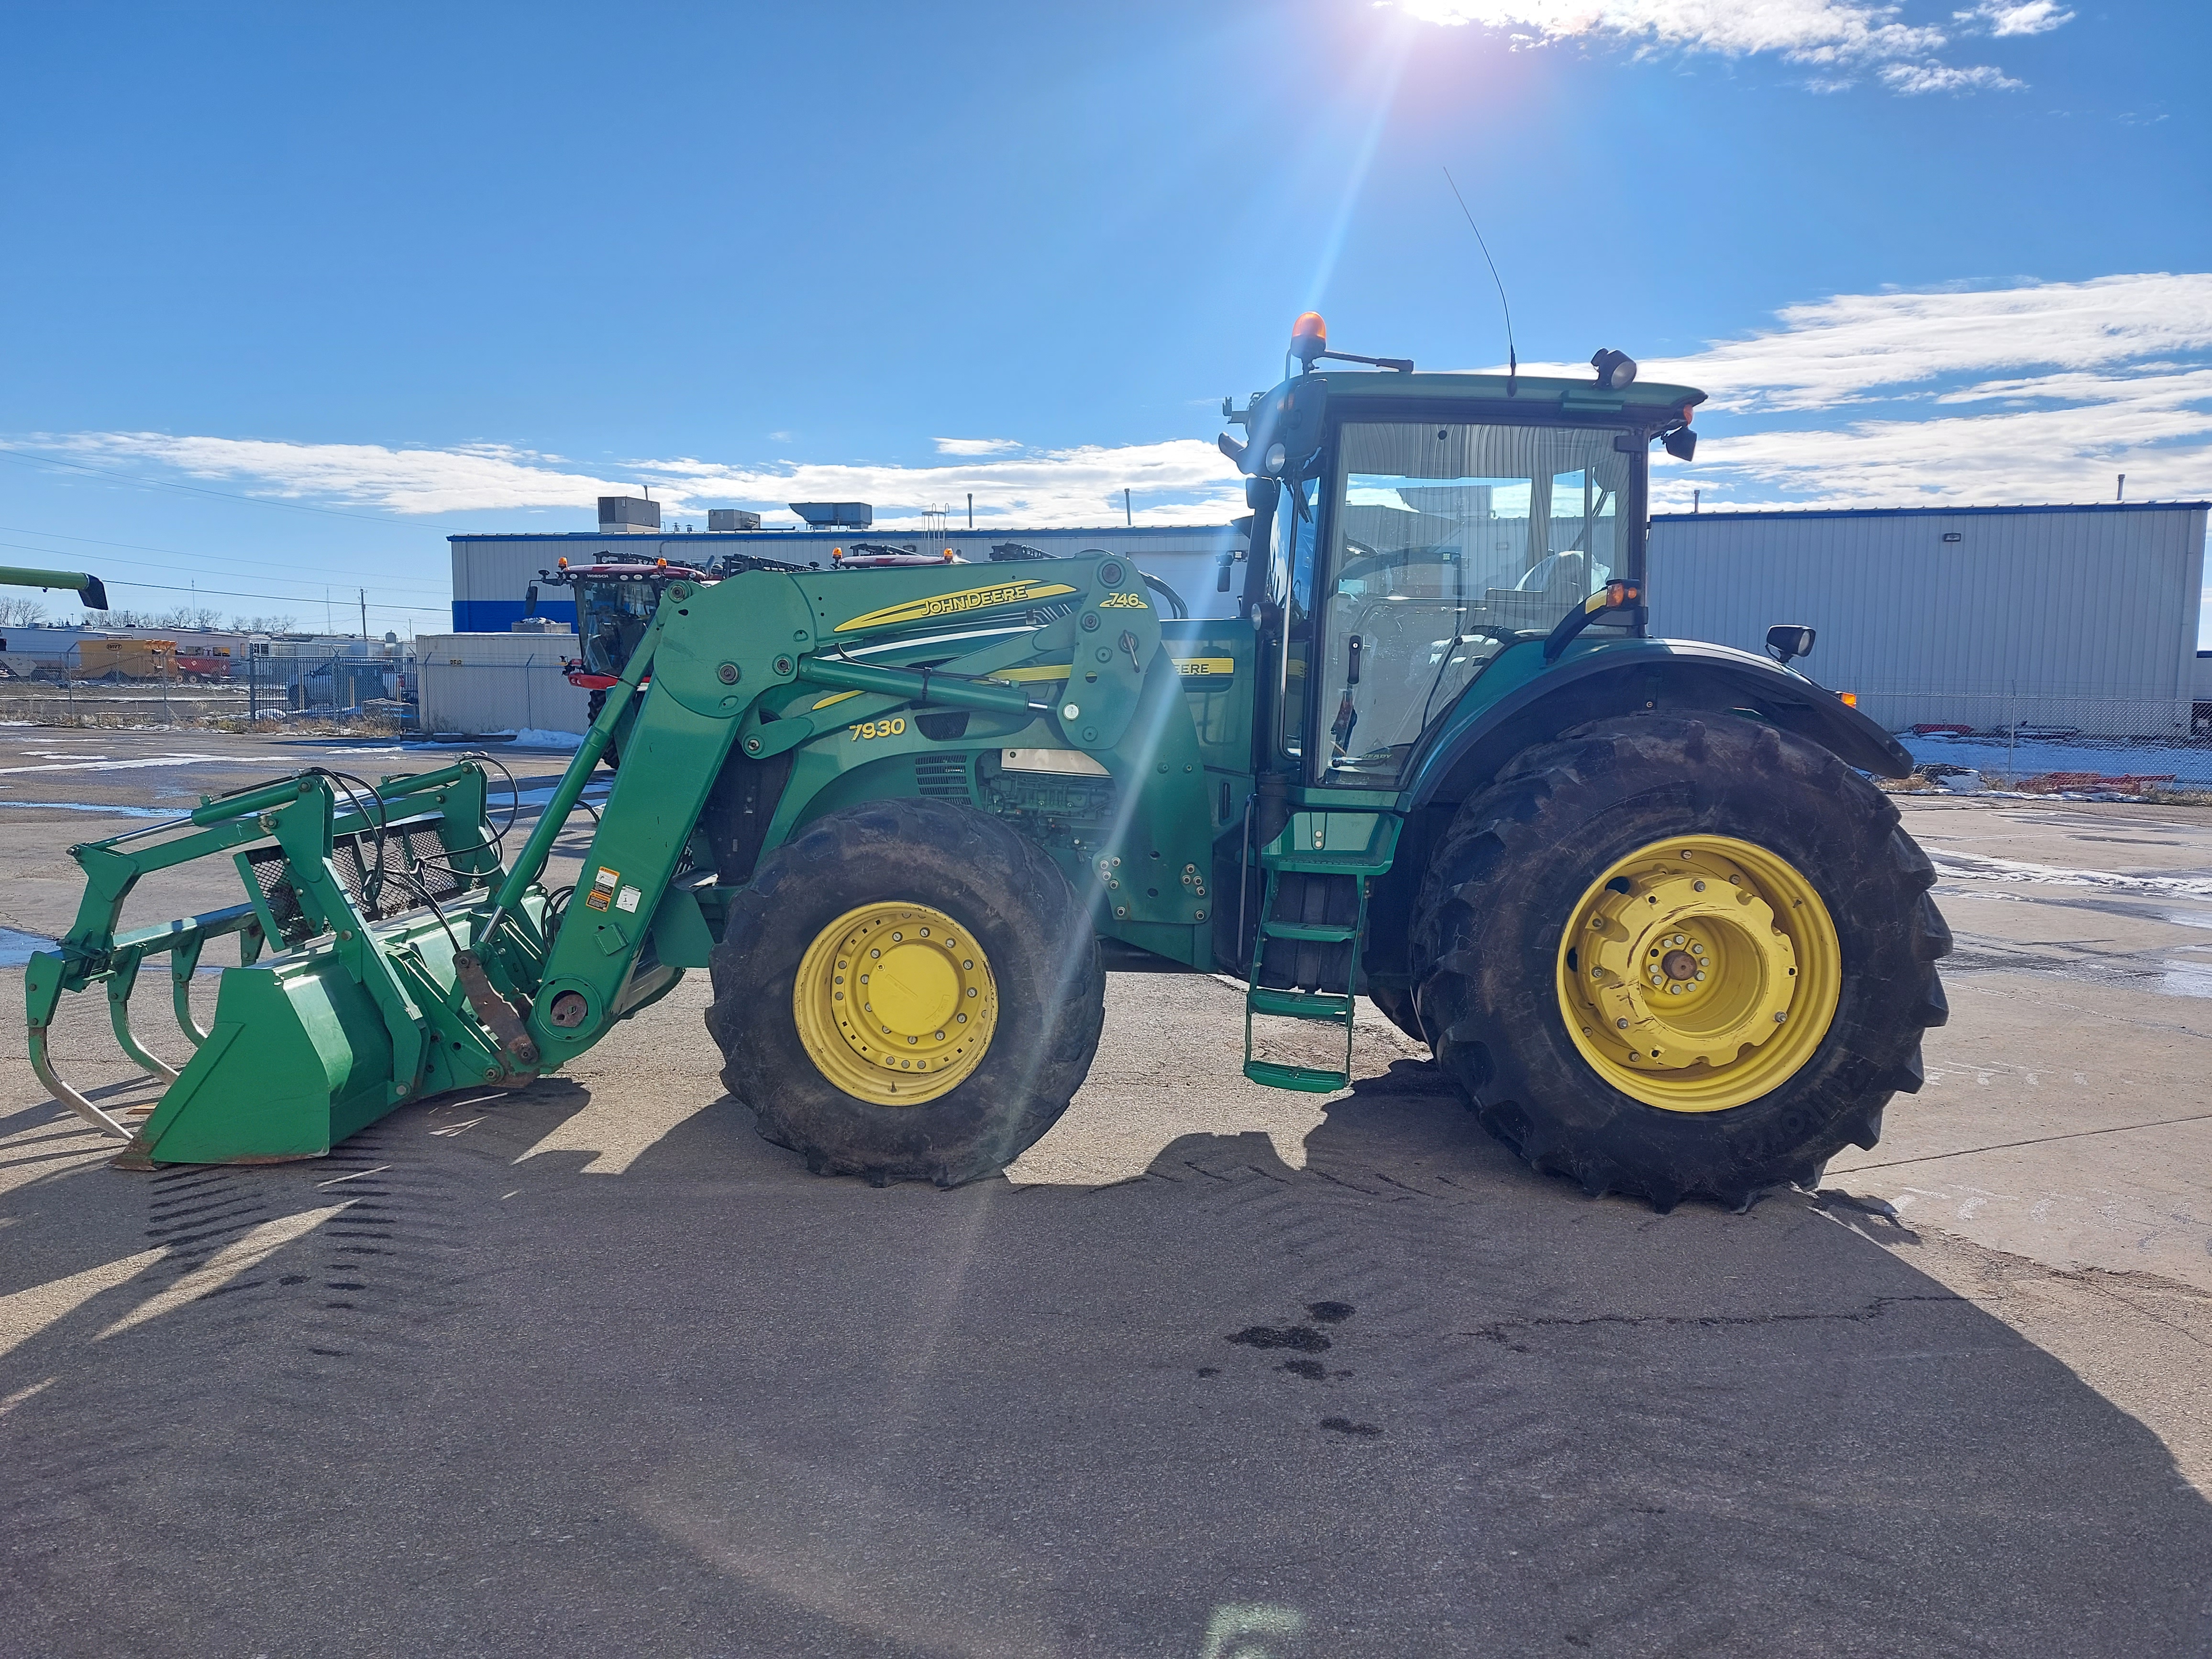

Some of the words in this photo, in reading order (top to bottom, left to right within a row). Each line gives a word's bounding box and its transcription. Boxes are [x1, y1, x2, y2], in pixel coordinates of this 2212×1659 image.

[921, 597, 966, 615] JOHN
[966, 586, 1029, 607] DEERE
[1109, 593, 1139, 606] 746
[849, 718, 905, 741] 7930
